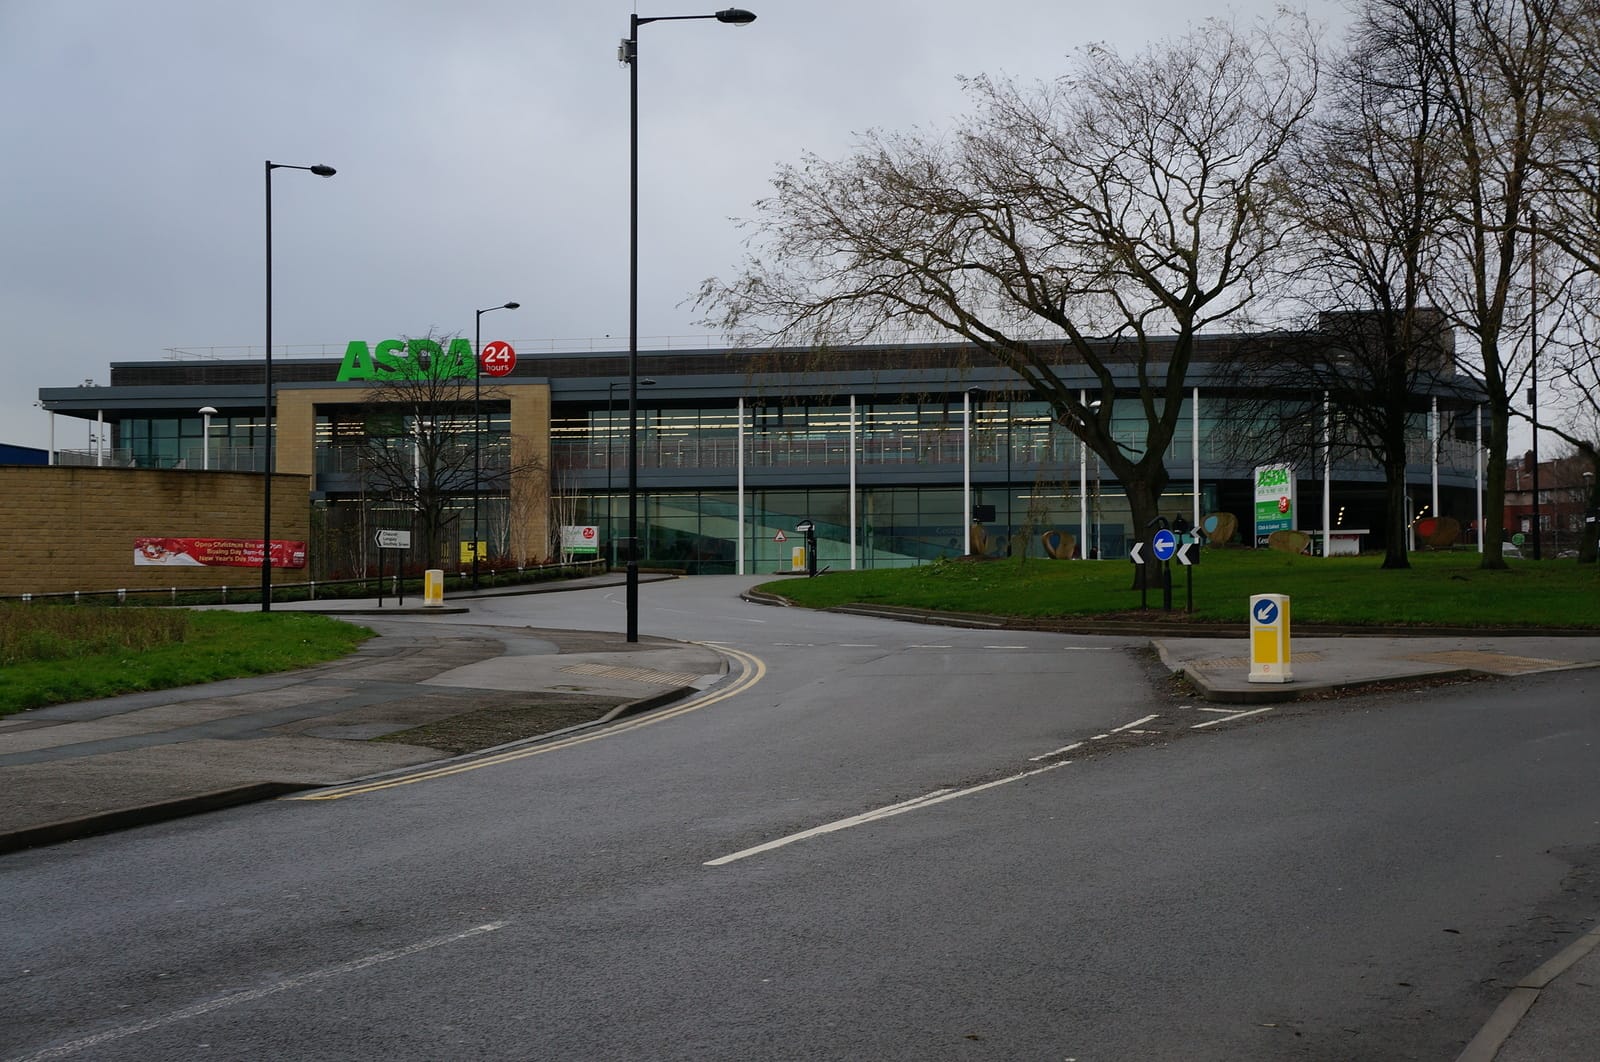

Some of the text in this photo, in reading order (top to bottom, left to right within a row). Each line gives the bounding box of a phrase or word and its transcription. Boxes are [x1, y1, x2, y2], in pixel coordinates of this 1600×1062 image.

[484, 346, 510, 363] 24
[336, 338, 477, 382] ASDA
[486, 364, 509, 372] hours
[194, 541, 212, 549] Open
[213, 541, 243, 549] Christmas
[207, 548, 228, 556] Boxing
